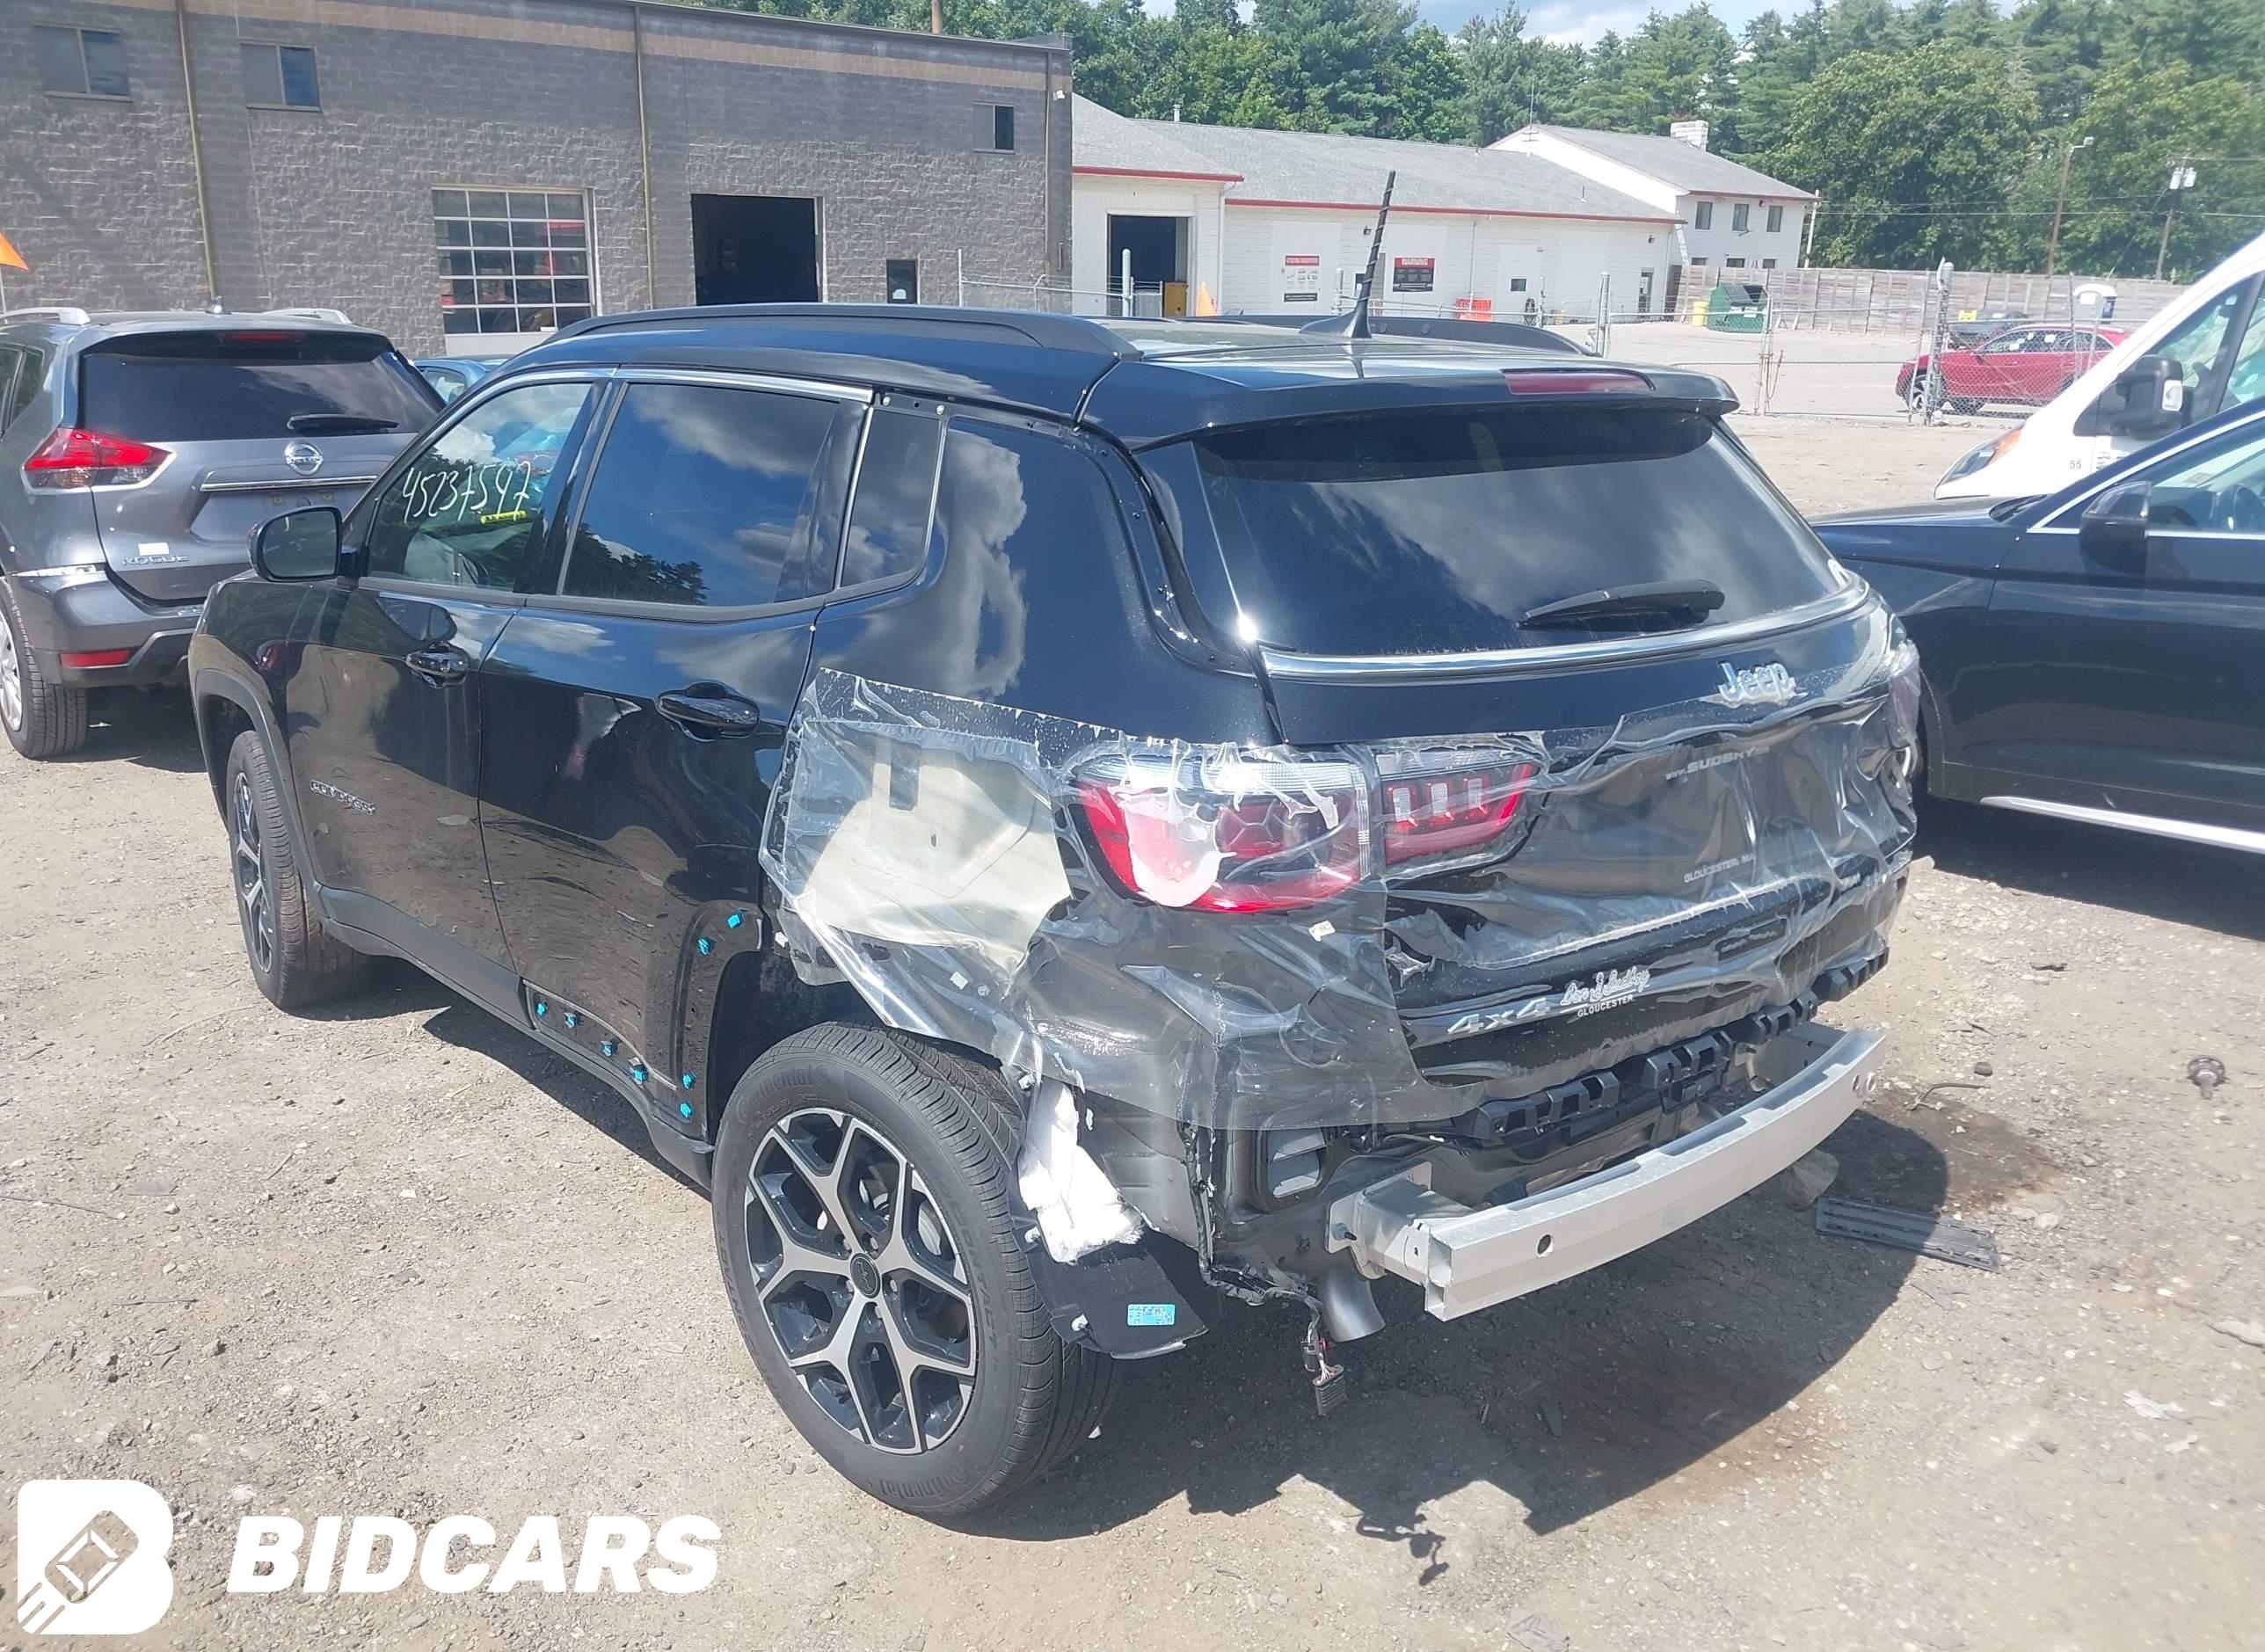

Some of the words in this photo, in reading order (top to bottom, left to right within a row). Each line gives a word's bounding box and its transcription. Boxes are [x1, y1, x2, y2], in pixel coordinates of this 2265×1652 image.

[1717, 662, 1797, 702] Jeep
[1447, 998, 1550, 1034] 4x4
[1577, 993, 1633, 1017] GLOUCESTER
